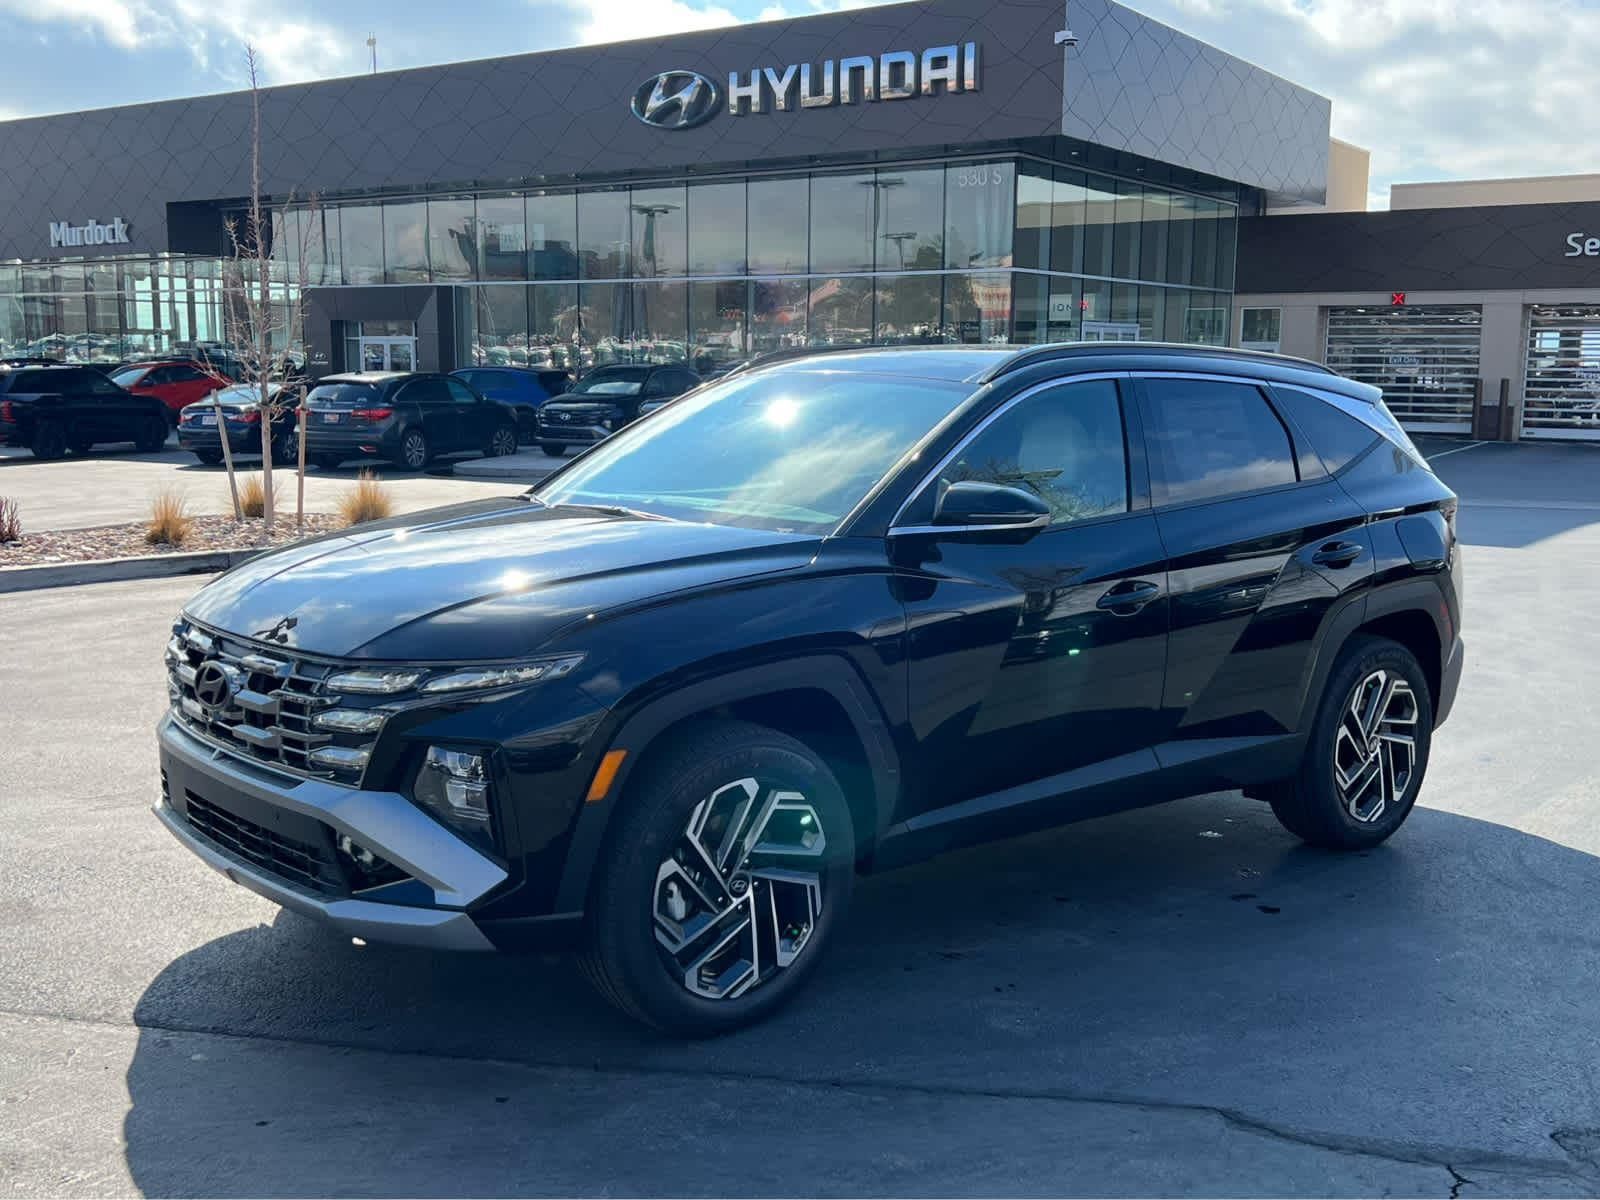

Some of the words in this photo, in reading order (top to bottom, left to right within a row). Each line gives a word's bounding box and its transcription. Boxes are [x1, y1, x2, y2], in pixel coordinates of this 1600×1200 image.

[728, 41, 977, 116] HYUNDAI
[993, 169, 1001, 185] S
[50, 217, 129, 248] Murdock
